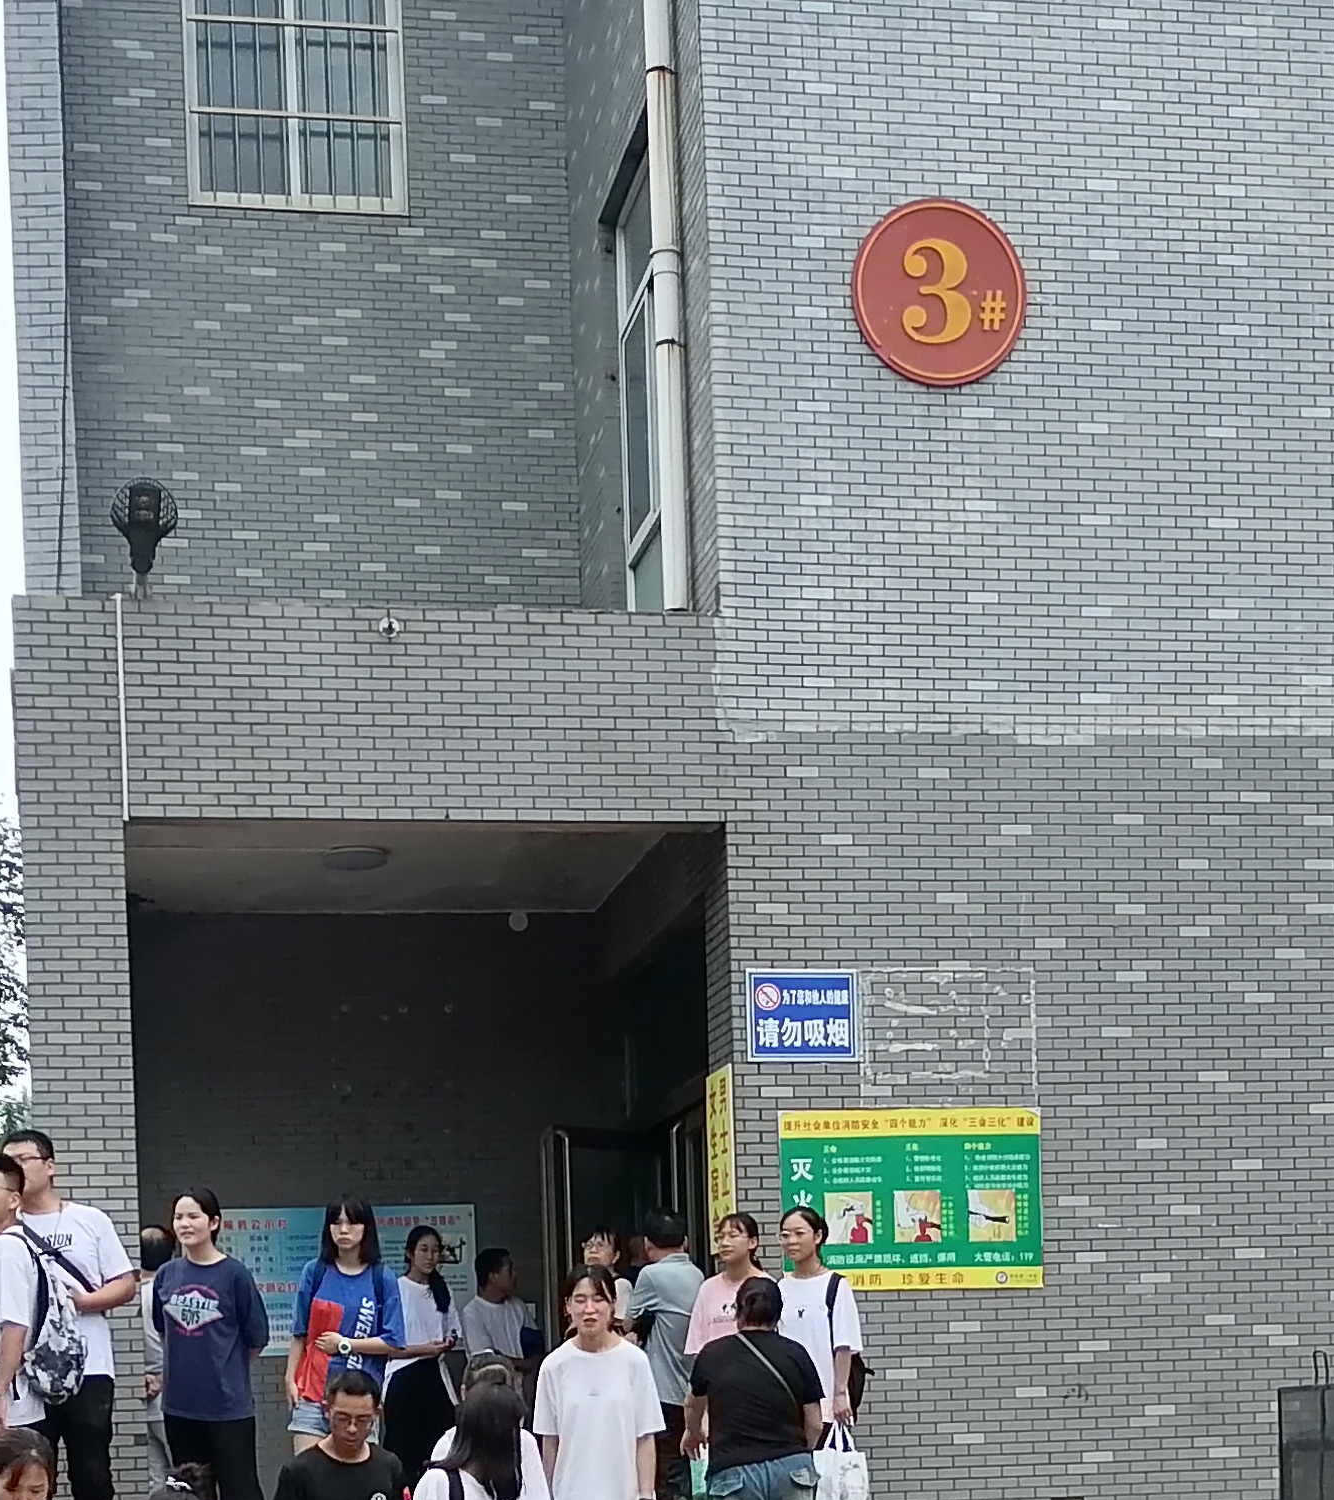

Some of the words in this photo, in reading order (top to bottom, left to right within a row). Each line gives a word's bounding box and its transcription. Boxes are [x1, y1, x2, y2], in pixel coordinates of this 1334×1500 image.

[757, 1017, 849, 1048] 请勿吸烟
[719, 1077, 730, 1213] 男士止
[43, 1233, 72, 1248] SION
[901, 1272, 965, 1285] 珍爱生命
[170, 1294, 219, 1311] BEASTIE
